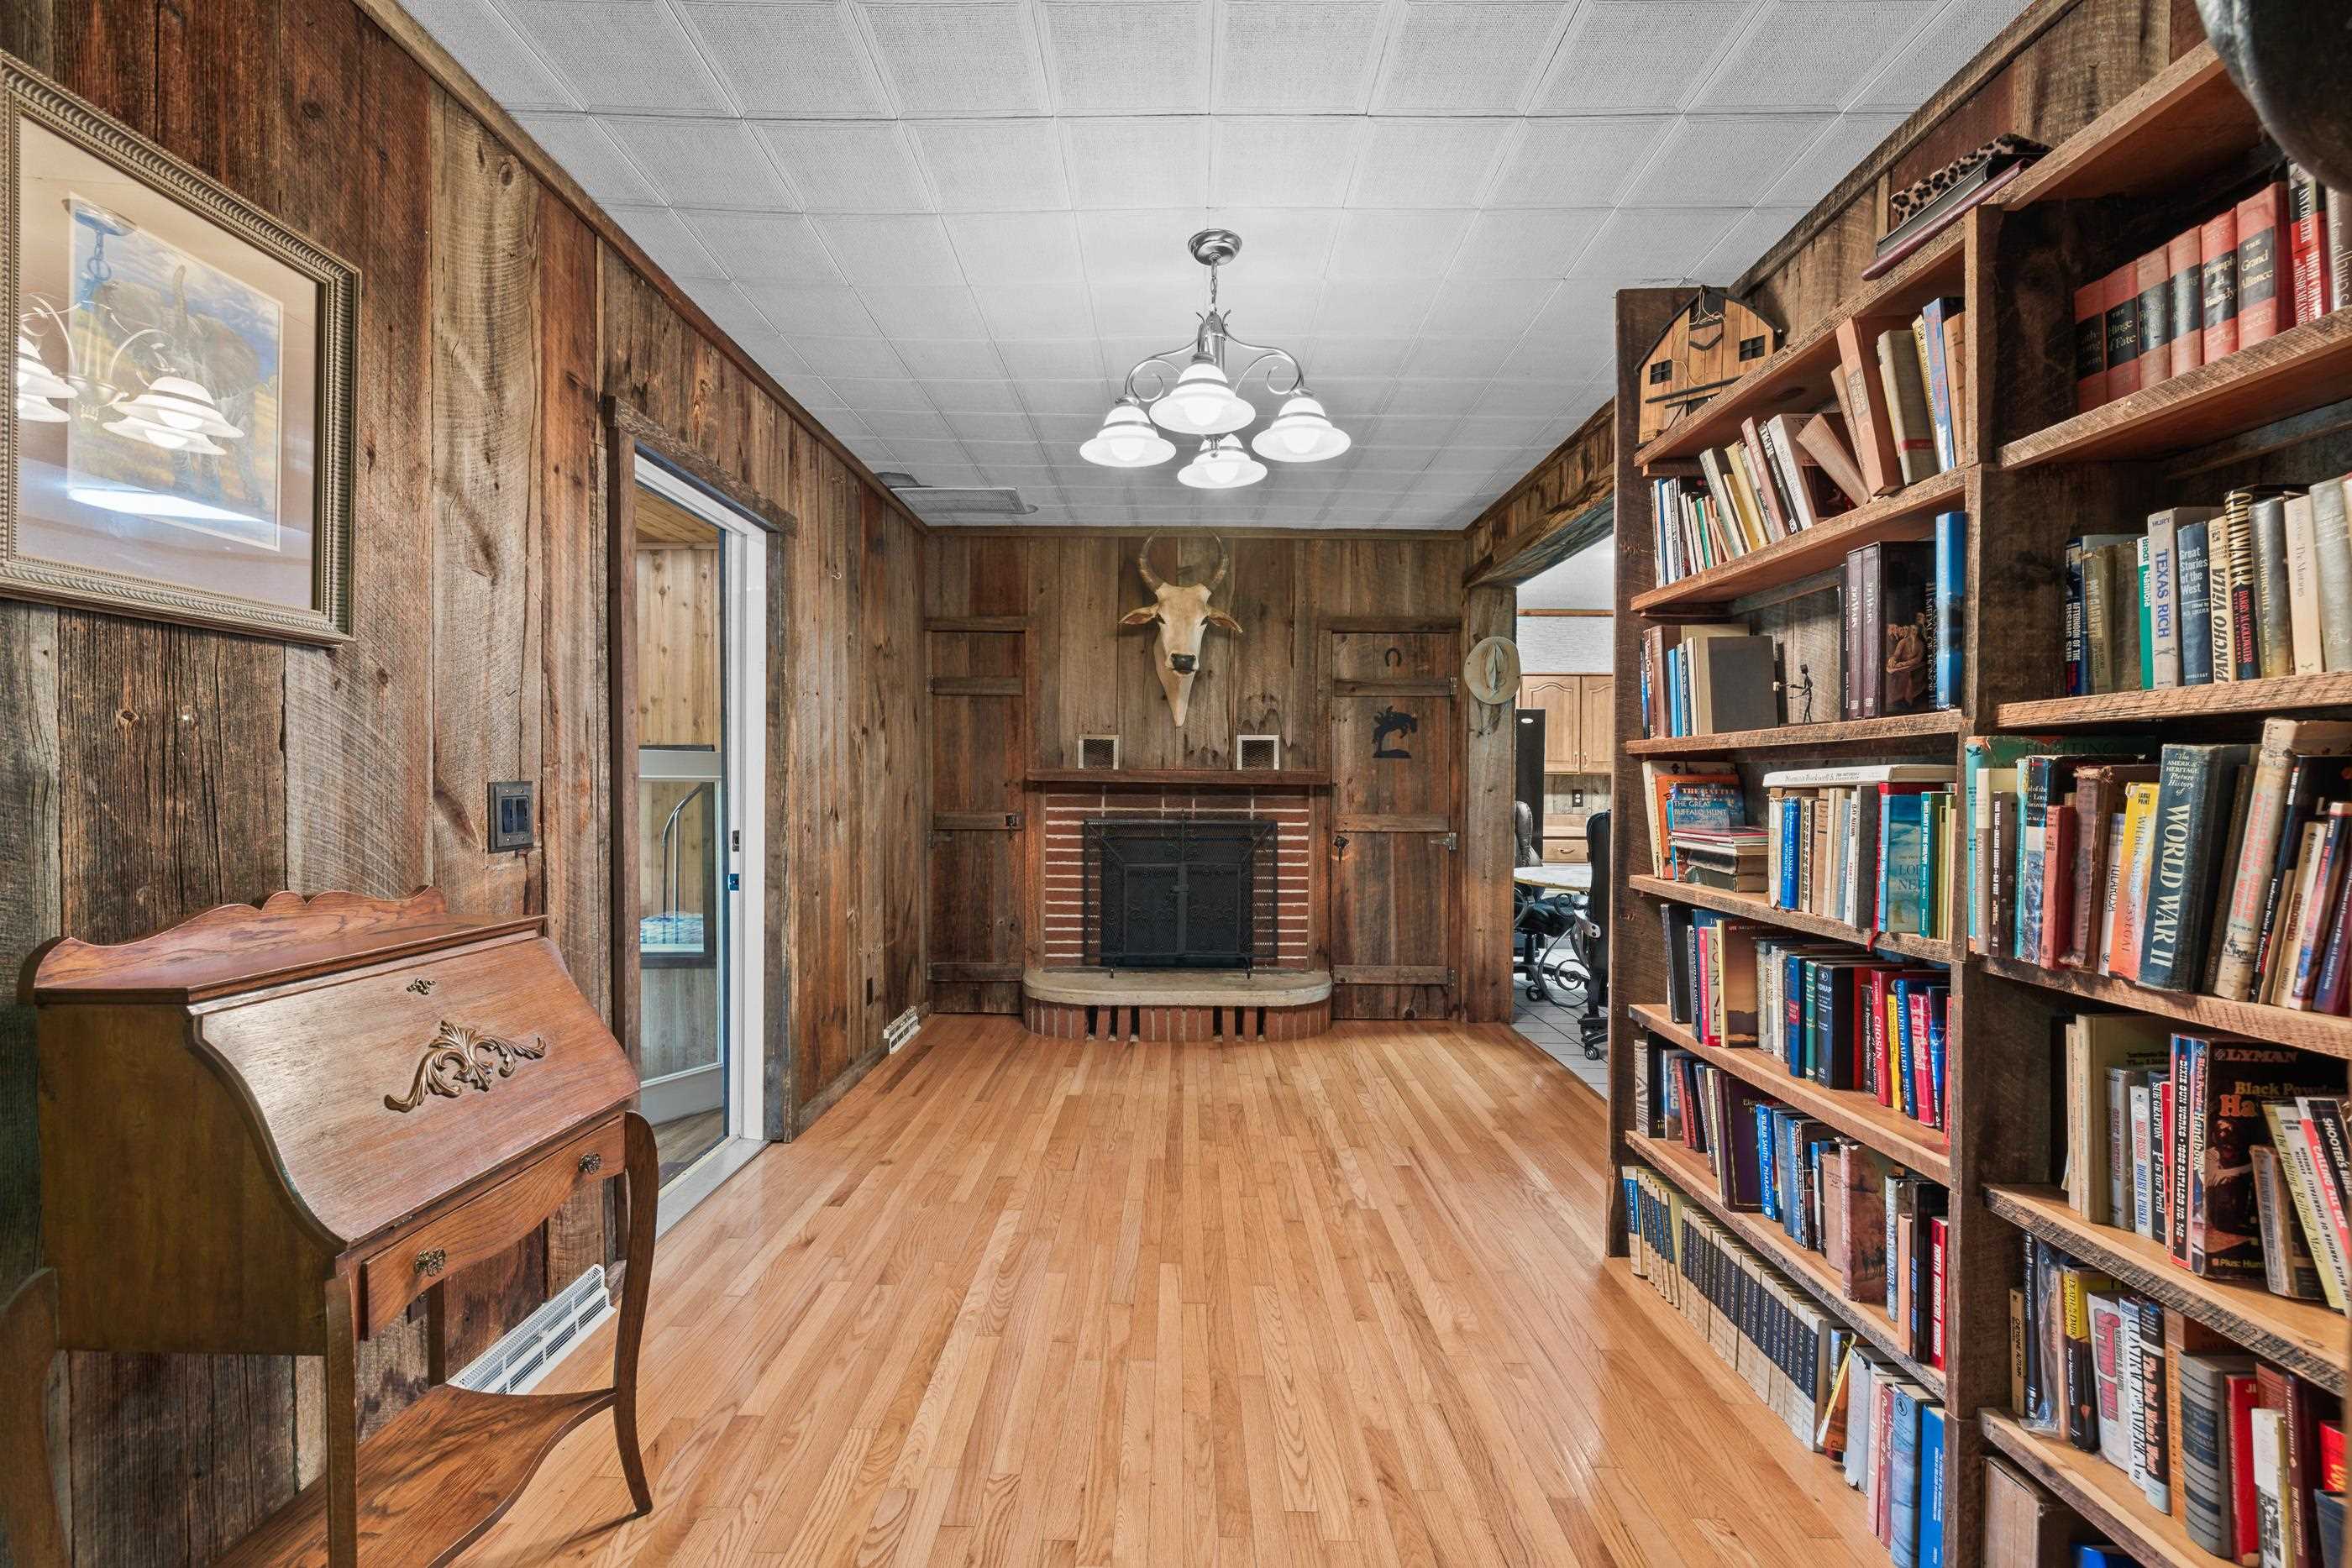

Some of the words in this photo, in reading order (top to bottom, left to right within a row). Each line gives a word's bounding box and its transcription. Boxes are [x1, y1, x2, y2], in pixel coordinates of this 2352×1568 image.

[2298, 187, 2310, 204] ANN
[2299, 205, 2312, 244] COULTER
[2241, 249, 2270, 272] Grand
[2241, 270, 2273, 290] Alliance
[2203, 287, 2237, 308] Tragedy
[2117, 334, 2136, 349] Fate
[1760, 423, 1775, 459] TIGER
[2179, 546, 2201, 560] Great
[2180, 559, 2208, 572] Stories
[2155, 549, 2169, 599] TEXAS
[2181, 574, 2188, 585] of
[2190, 571, 2203, 581] the
[2260, 557, 2270, 614] CHURCHILL
[2143, 570, 2151, 608] Namibia
[2181, 584, 2202, 594] West
[2239, 590, 2250, 612] BARRY
[2071, 602, 2081, 638] AFTERNOON
[2157, 602, 2170, 638] RICH
[2072, 639, 2081, 648] OF
[2072, 649, 2081, 661] THE
[2213, 616, 2229, 682] PANCHO
[2242, 623, 2253, 663] GOLDWATER
[2176, 753, 2190, 761] The
[2167, 779, 2194, 789] History
[2170, 773, 2194, 781] Picture
[2176, 788, 2186, 796] of
[2134, 815, 2148, 857] WILBUR
[2160, 803, 2192, 889] WORLD
[2108, 863, 2120, 913] TULAROSA
[2153, 894, 2181, 945] WAR
[2286, 892, 2303, 941] GERONIMO
[2150, 947, 2174, 968] II
[2255, 936, 2266, 973] Construction
[1874, 1015, 1882, 1060] CHOSIN
[2227, 1050, 2299, 1062] LYMAN
[2179, 1060, 2188, 1083] DIXIE
[2152, 1082, 2160, 1099] SUE
[2179, 1084, 2187, 1102] GUN
[2234, 1081, 2280, 1096] Black
[2153, 1099, 2163, 1140] GRAFTON
[2178, 1104, 2187, 1137] WORKS
[2152, 1149, 2164, 1161] P
[2193, 1111, 2206, 1172] Handbook
[2322, 1117, 2350, 1169] SHOOTER'S
[2136, 1163, 2147, 1190] ROBERT
[2154, 1161, 2163, 1172] is
[2155, 1174, 2164, 1190] for
[2176, 1164, 2186, 1204] CATALOG
[2276, 1132, 2287, 1151] The
[2282, 1151, 2299, 1189] Fighting
[2295, 1190, 2317, 1232] Railroad
[2312, 1144, 2334, 1187] CALLING
[2327, 1188, 2339, 1209] ALL
[2334, 1211, 2349, 1230] ELK
[2137, 1197, 2148, 1226] PARKER
[2155, 1190, 2166, 1214] Peril
[2176, 1207, 2185, 1219] NO.
[1887, 1251, 1896, 1285] HUNTER
[1934, 1243, 1942, 1275] NORTH
[1934, 1274, 1942, 1321] AMERICAN
[2068, 1278, 2076, 1303] DEATH
[1934, 1320, 1942, 1358] INDIANS
[2069, 1314, 2078, 1339] DARK
[2128, 1319, 2144, 1394] CONTRACT
[2143, 1355, 2157, 1380] The
[2144, 1380, 2158, 1407] Red
[2132, 1409, 2147, 1470] AMERICA
[2145, 1444, 2160, 1476] West
